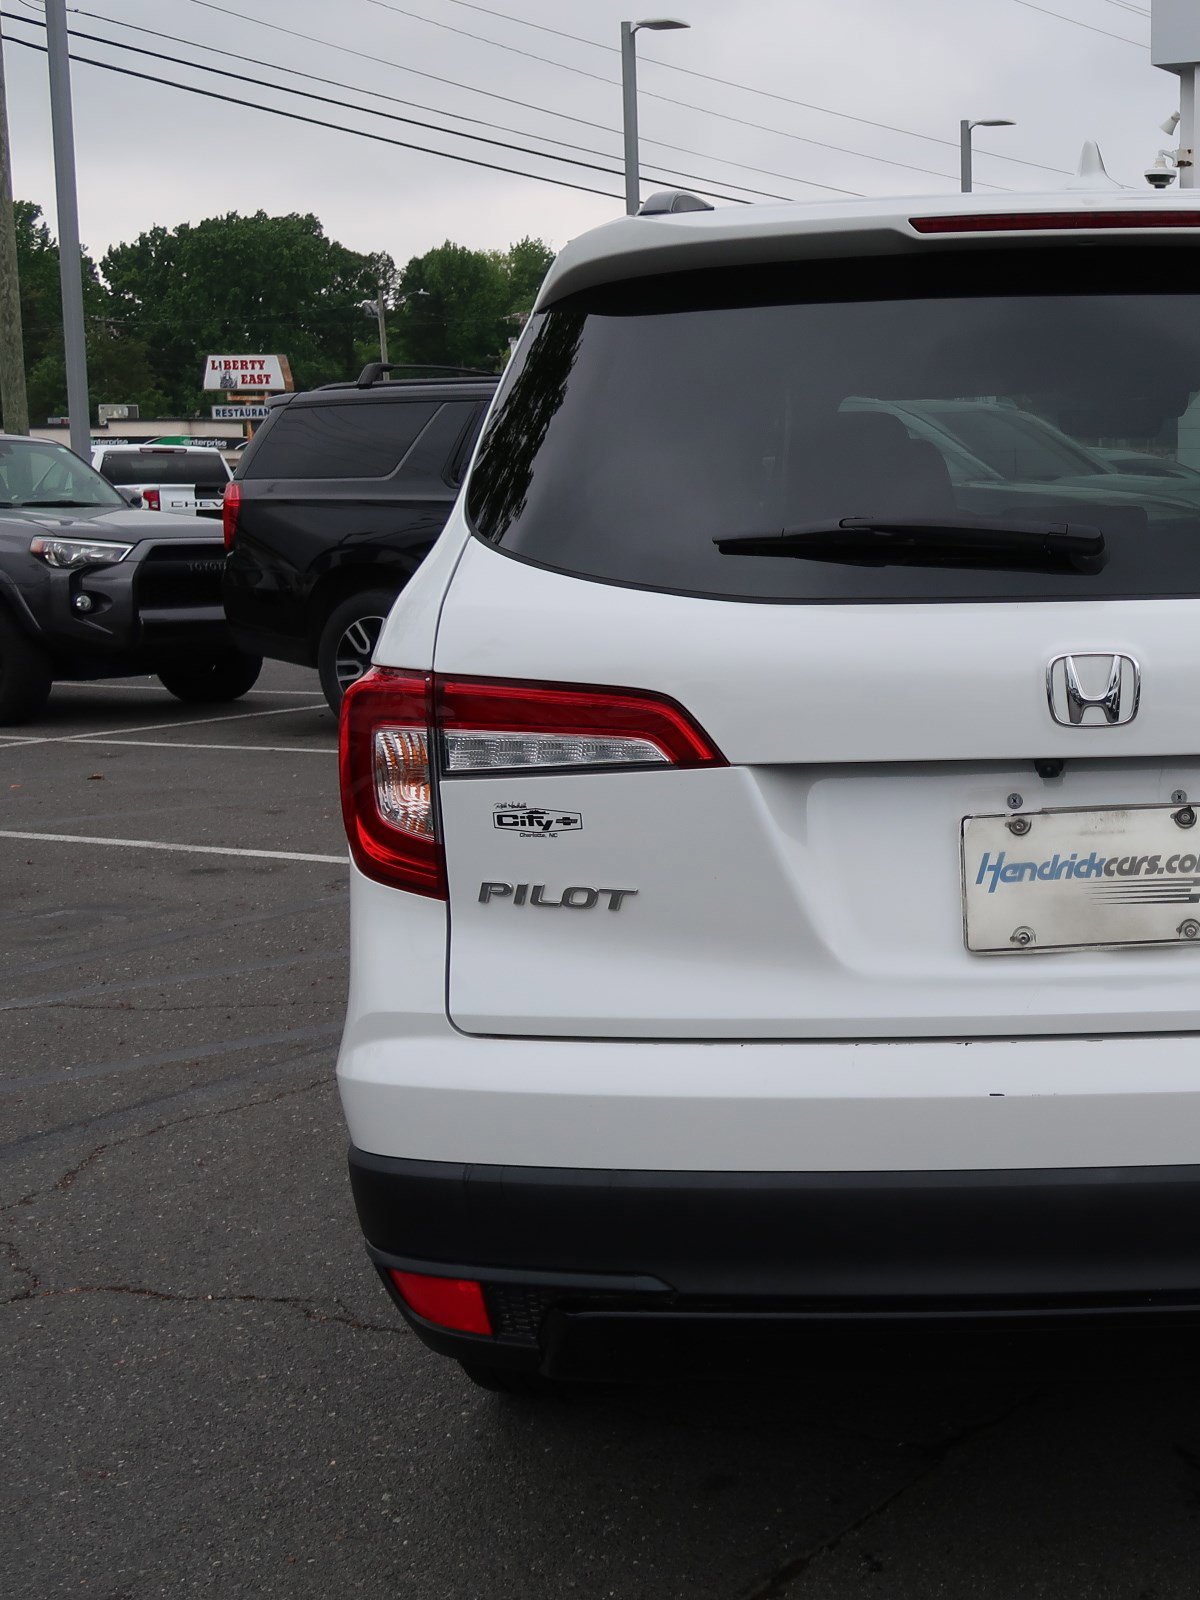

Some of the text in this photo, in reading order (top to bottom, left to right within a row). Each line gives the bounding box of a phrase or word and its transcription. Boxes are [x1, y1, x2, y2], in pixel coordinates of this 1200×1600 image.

[211, 360, 265, 370] LIBERTY
[241, 374, 271, 384] EAST
[183, 439, 227, 448] enterprise
[497, 815, 553, 830] City
[478, 881, 639, 912] PILOT
